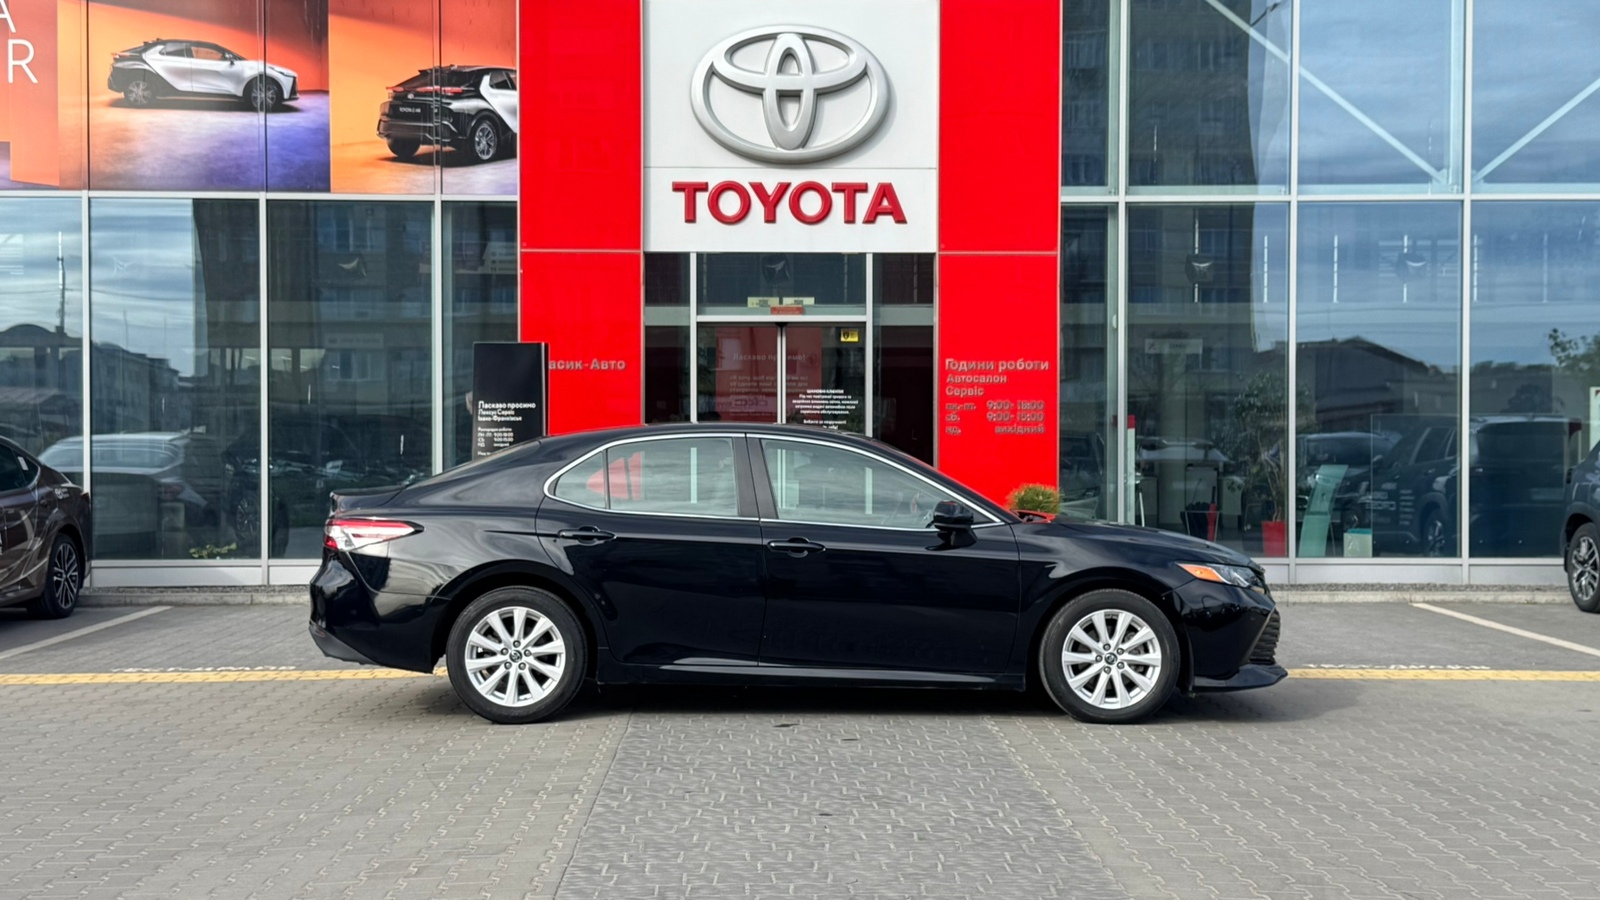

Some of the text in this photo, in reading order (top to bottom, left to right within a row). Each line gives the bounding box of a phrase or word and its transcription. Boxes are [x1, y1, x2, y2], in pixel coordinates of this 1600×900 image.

[672, 181, 908, 225] TOYOTA
[548, 358, 626, 370] асик-Авто
[945, 358, 1049, 372] Години роботи
[946, 374, 1007, 383] Автосалон
[945, 385, 985, 398] Сервіс
[507, 402, 537, 411] просимо
[994, 423, 1045, 434] вихідний
